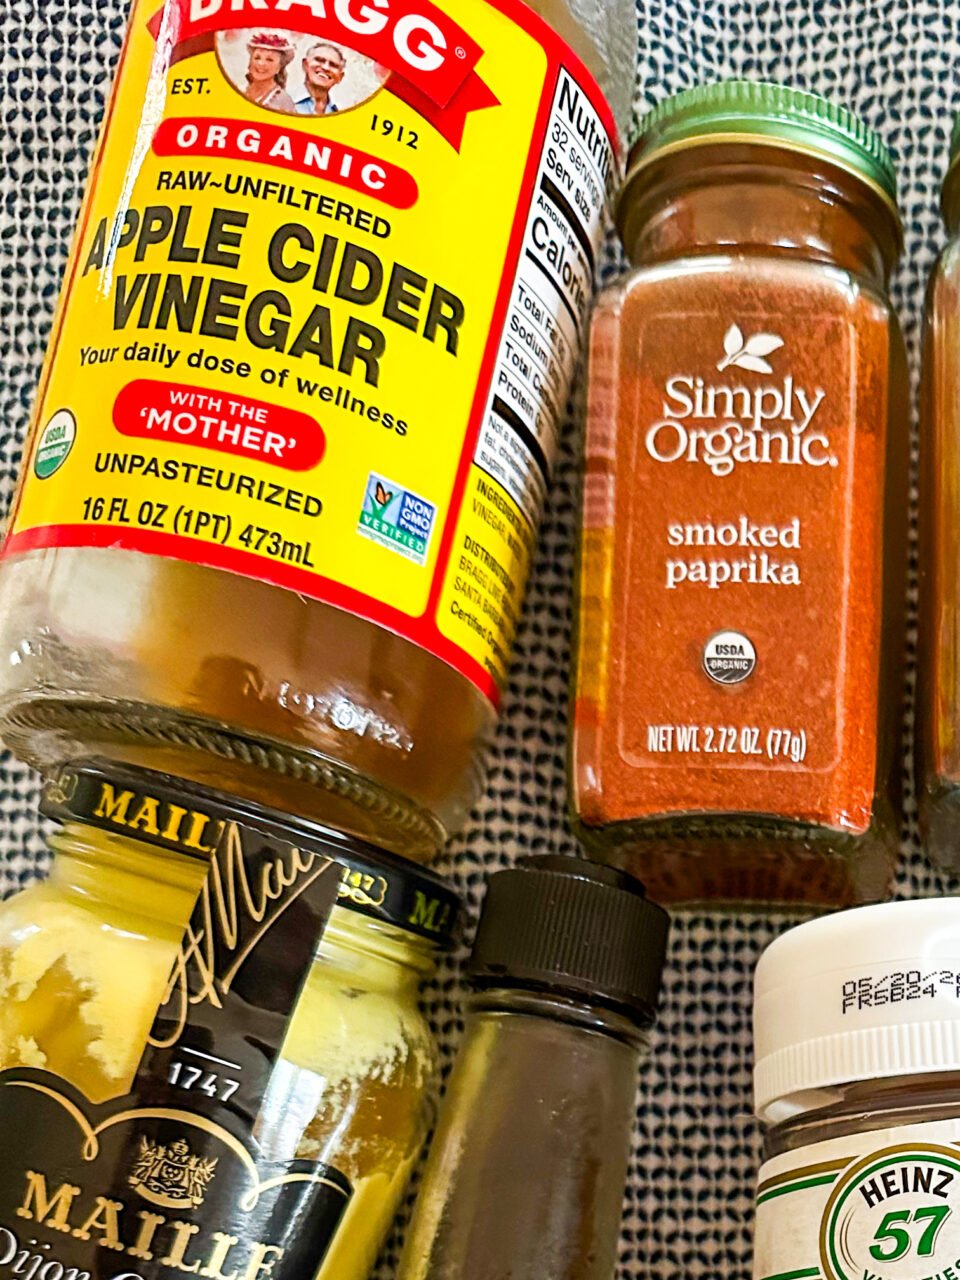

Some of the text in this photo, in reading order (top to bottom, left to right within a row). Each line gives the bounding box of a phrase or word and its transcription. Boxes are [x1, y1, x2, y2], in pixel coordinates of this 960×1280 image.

[171, 78, 211, 95] EST.
[370, 114, 419, 149] 1912
[552, 122, 569, 152] 32
[176, 123, 389, 191] ORGANIC
[546, 148, 575, 191] Serv
[82, 205, 467, 357] APPLE CIDER
[518, 285, 545, 327] Total
[112, 273, 388, 389] VINEGAR
[509, 314, 550, 370] Sodium
[80, 341, 409, 437] Your daily dose of wellness
[169, 390, 269, 425] WITH THE
[498, 370, 535, 424] Protein
[662, 375, 826, 433] Simply
[94, 452, 323, 518] UNPASTEURIZED
[401, 509, 431, 531] GMO
[404, 495, 432, 519] NON
[82, 497, 316, 569] 16 FL OZ (1PT) 473mL
[363, 514, 425, 552] VERIFIED
[667, 516, 801, 548] smoked
[665, 552, 801, 588] paprika
[710, 659, 749, 670] ORGANIC
[715, 644, 745, 656] USDA
[648, 726, 807, 762] NET WT. 2.72 OZ. (77g)
[93, 782, 225, 852] MAIL
[168, 1062, 240, 1103] 1747
[858, 1166, 955, 1210] HEINZ
[868, 1204, 952, 1264] 57
